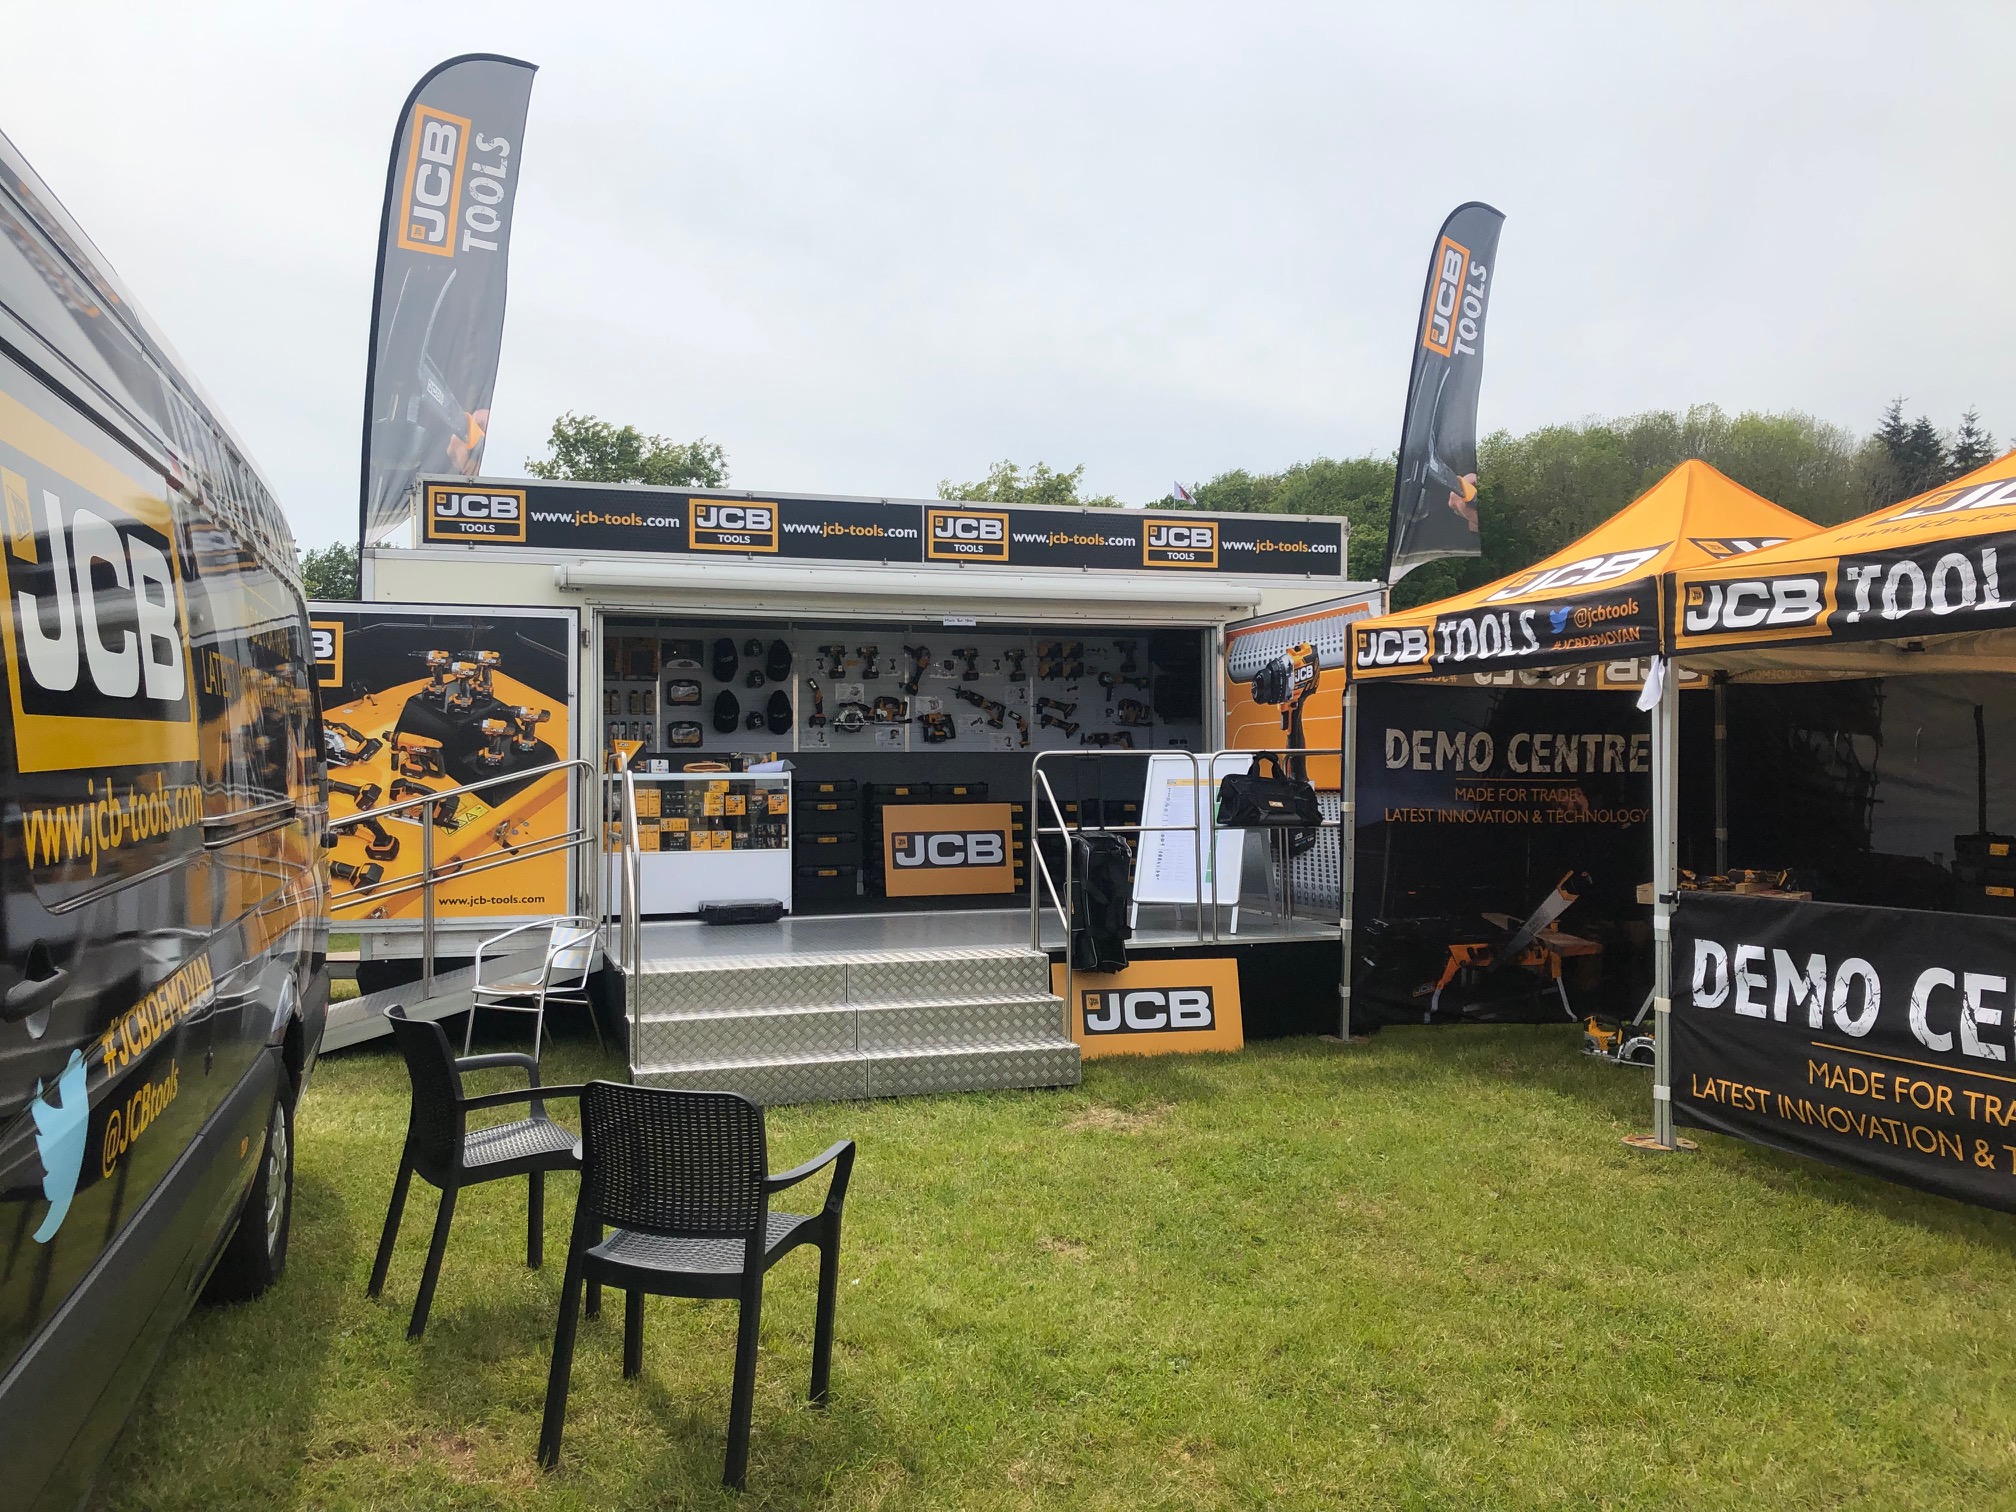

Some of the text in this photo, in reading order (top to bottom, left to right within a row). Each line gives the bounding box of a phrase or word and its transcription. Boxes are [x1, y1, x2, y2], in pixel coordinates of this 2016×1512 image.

[413, 120, 457, 242] JCB
[462, 132, 512, 252] TOOLS
[1432, 249, 1463, 344] JCB
[1454, 261, 1488, 356] TOOLS
[436, 495, 518, 518] JCB
[531, 510, 680, 528] www.jcb-tools.com
[697, 507, 771, 530] JCB
[459, 523, 495, 533] TOOLS
[718, 534, 750, 544] TOOLS
[783, 522, 918, 539] www.jcb-tools.com
[935, 518, 1002, 540] JCB
[1013, 531, 1136, 547] www.jcb-tools.com
[1150, 527, 1213, 547] JCB
[954, 544, 984, 553] TOOLS
[1167, 552, 1195, 560] TOOLS
[1222, 539, 1337, 554] www.jcb-tools.com
[1487, 549, 1661, 601] JCB
[18, 490, 185, 701] JCB
[1686, 579, 1822, 632] JCB
[1573, 597, 1640, 628] @jcbtools
[1357, 609, 1540, 667] JCB TOOLS
[1551, 626, 1640, 651] #JCBDEMOVAN
[1295, 665, 1313, 682] JCB
[1385, 728, 1650, 774] DEMO CENTRE
[1455, 788, 1577, 802] MADE FOR TRADE
[23, 771, 203, 877] www.jcb-tools.com
[1385, 808, 1650, 824] LATEST INNOVATION & TECHNOLOGY
[895, 833, 1004, 866] JCB
[439, 894, 545, 906] www.jcb-tools.com
[101, 953, 214, 1078] #JCBDEMOVAN
[1086, 991, 1212, 1031] JCB
[1692, 938, 2016, 1062] DEMO CE
[1808, 1059, 1886, 1098] MADE
[1895, 1077, 1955, 1117] FOR
[103, 1058, 180, 1178] @JCBtools
[1692, 1074, 1771, 1114] LATEST
[1778, 1093, 1964, 1163] INNOVATION
[1974, 1138, 1996, 1170] &
